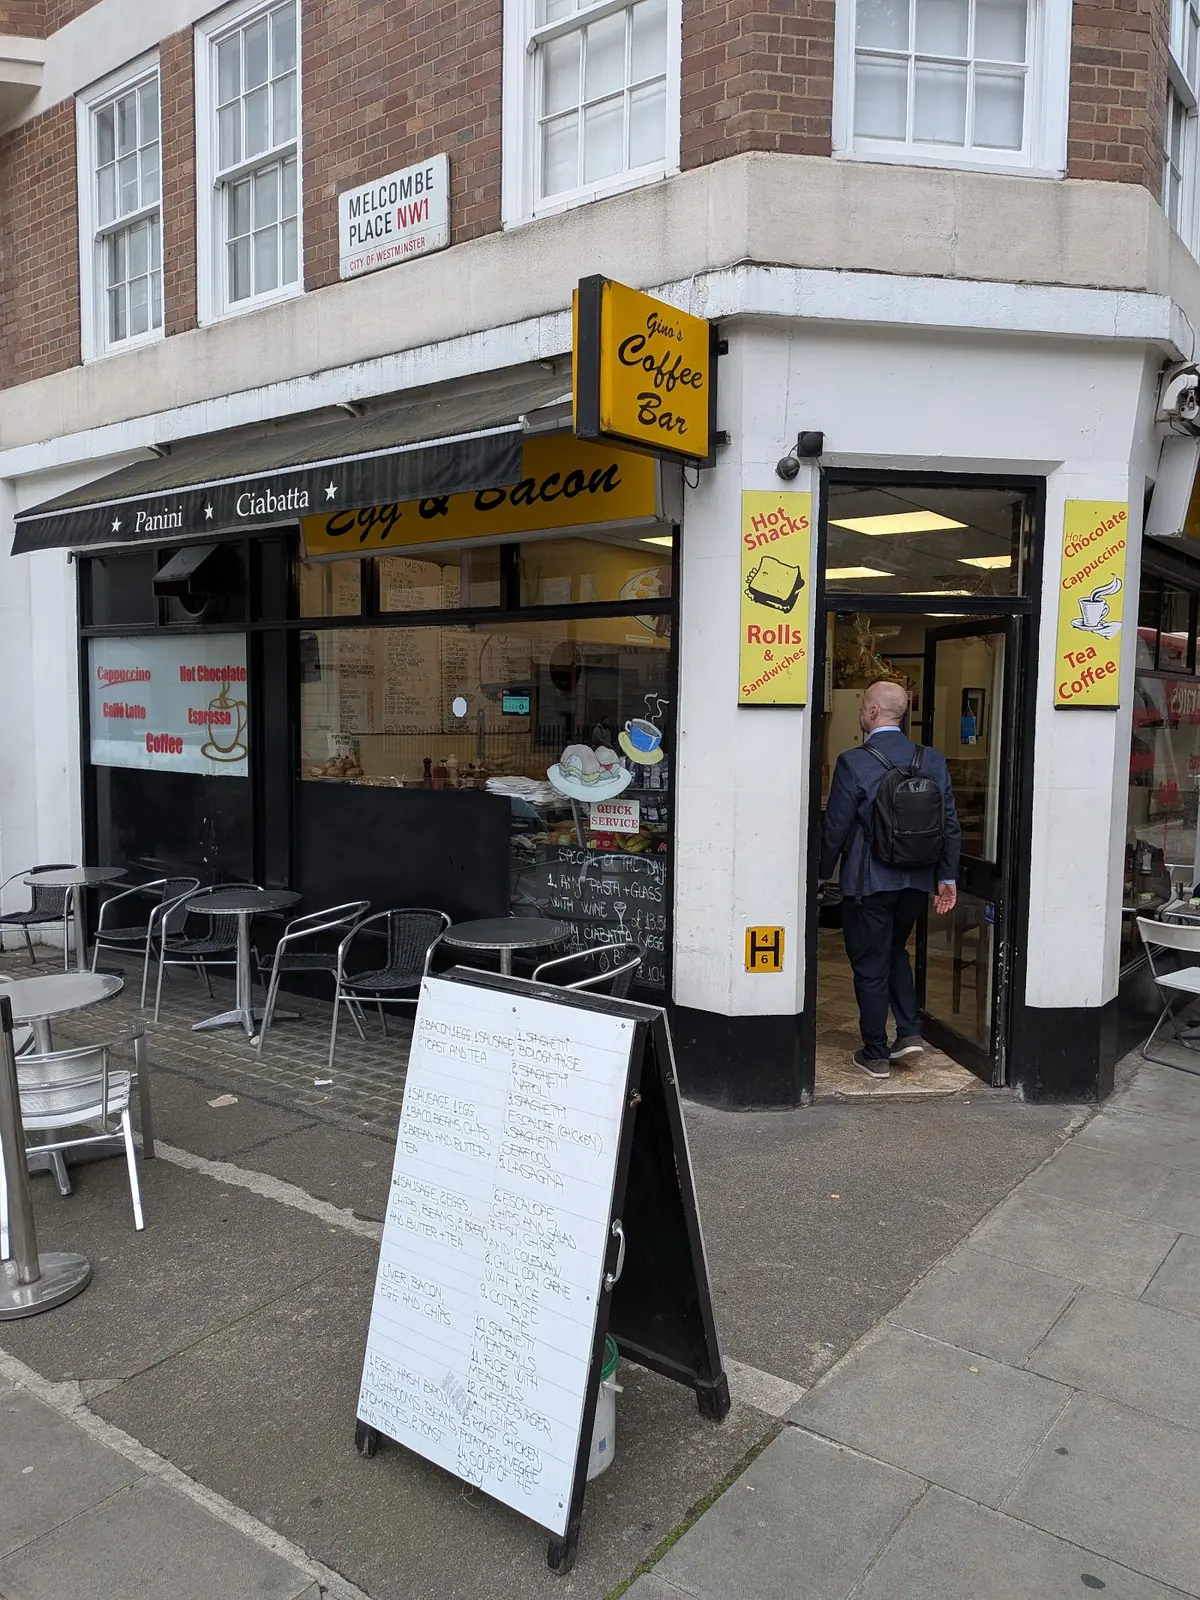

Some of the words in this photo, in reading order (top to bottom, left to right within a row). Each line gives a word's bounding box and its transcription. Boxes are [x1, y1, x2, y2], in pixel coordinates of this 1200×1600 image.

[349, 167, 434, 220] MELCOMBE
[349, 212, 392, 247] PLACE
[397, 197, 429, 230] NW1
[350, 258, 364, 272] CITY
[366, 254, 374, 266] OF
[376, 236, 426, 262] WESTMINSTER
[646, 312, 683, 342] Gino's
[618, 334, 704, 392] Coffee
[637, 392, 688, 435] Bar
[134, 505, 183, 533] Panini
[236, 486, 310, 517] Ciabatta
[750, 506, 788, 532] Hot
[744, 515, 809, 551] Snacks
[1064, 509, 1128, 559] Chocolate
[1064, 531, 1082, 543] Hot
[1062, 539, 1126, 590] Cappuccino
[747, 624, 802, 644] Rolls
[764, 649, 774, 662] &
[1064, 646, 1097, 670] Tea
[97, 666, 151, 686] Cappuccino
[180, 666, 195, 682] Hot
[197, 664, 246, 682] Chocolate
[741, 647, 806, 697] Sandwiches
[1058, 659, 1118, 700] Coffee
[188, 708, 231, 726] Espresso
[146, 732, 184, 755] Coffee
[596, 804, 632, 816] QUICK
[591, 816, 638, 828] SERVICE
[586, 878, 621, 898] PASTA
[550, 896, 574, 913] WITH
[580, 896, 608, 918] WINE
[584, 924, 632, 944] CIABATTA
[762, 934, 768, 943] 4
[751, 931, 780, 967] H
[761, 954, 768, 964] 6
[467, 1047, 487, 1066] TEA
[399, 1139, 419, 1156] TEA
